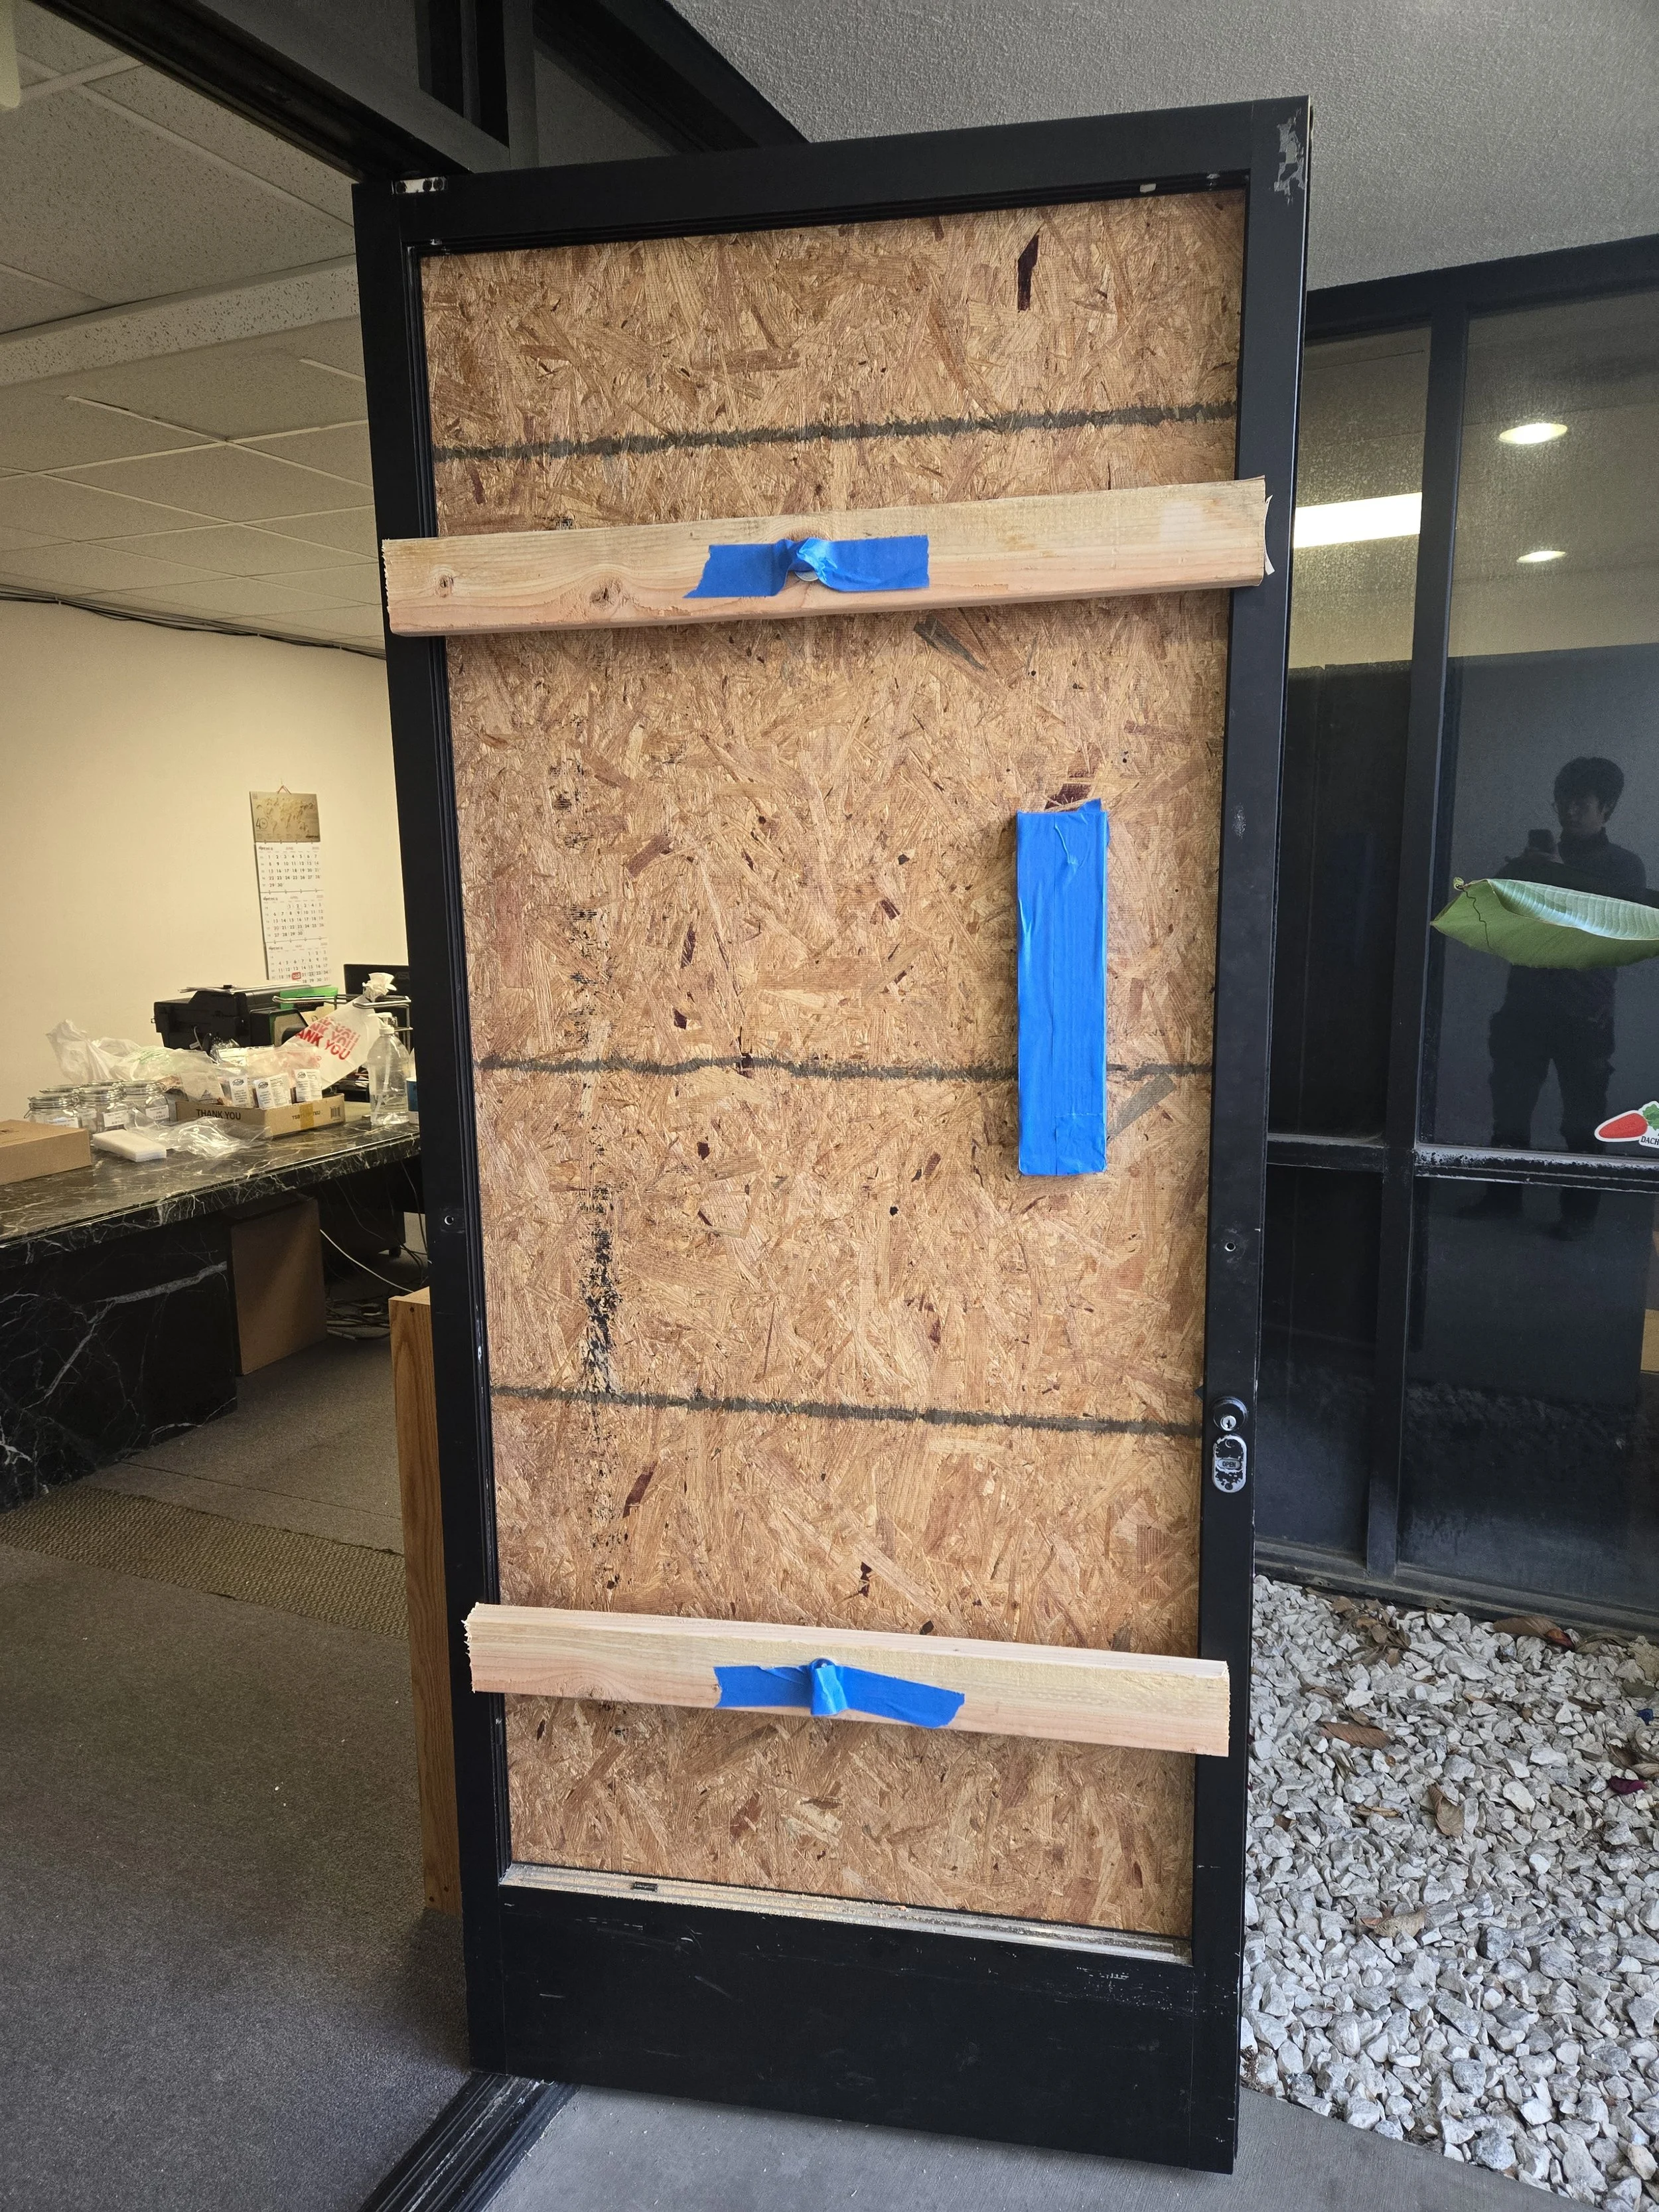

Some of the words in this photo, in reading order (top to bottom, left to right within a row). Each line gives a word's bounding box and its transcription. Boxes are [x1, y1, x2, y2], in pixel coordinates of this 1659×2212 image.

[325, 1039, 350, 1060] YOU
[196, 1109, 223, 1118] THANK
[224, 1112, 241, 1120] YOU
